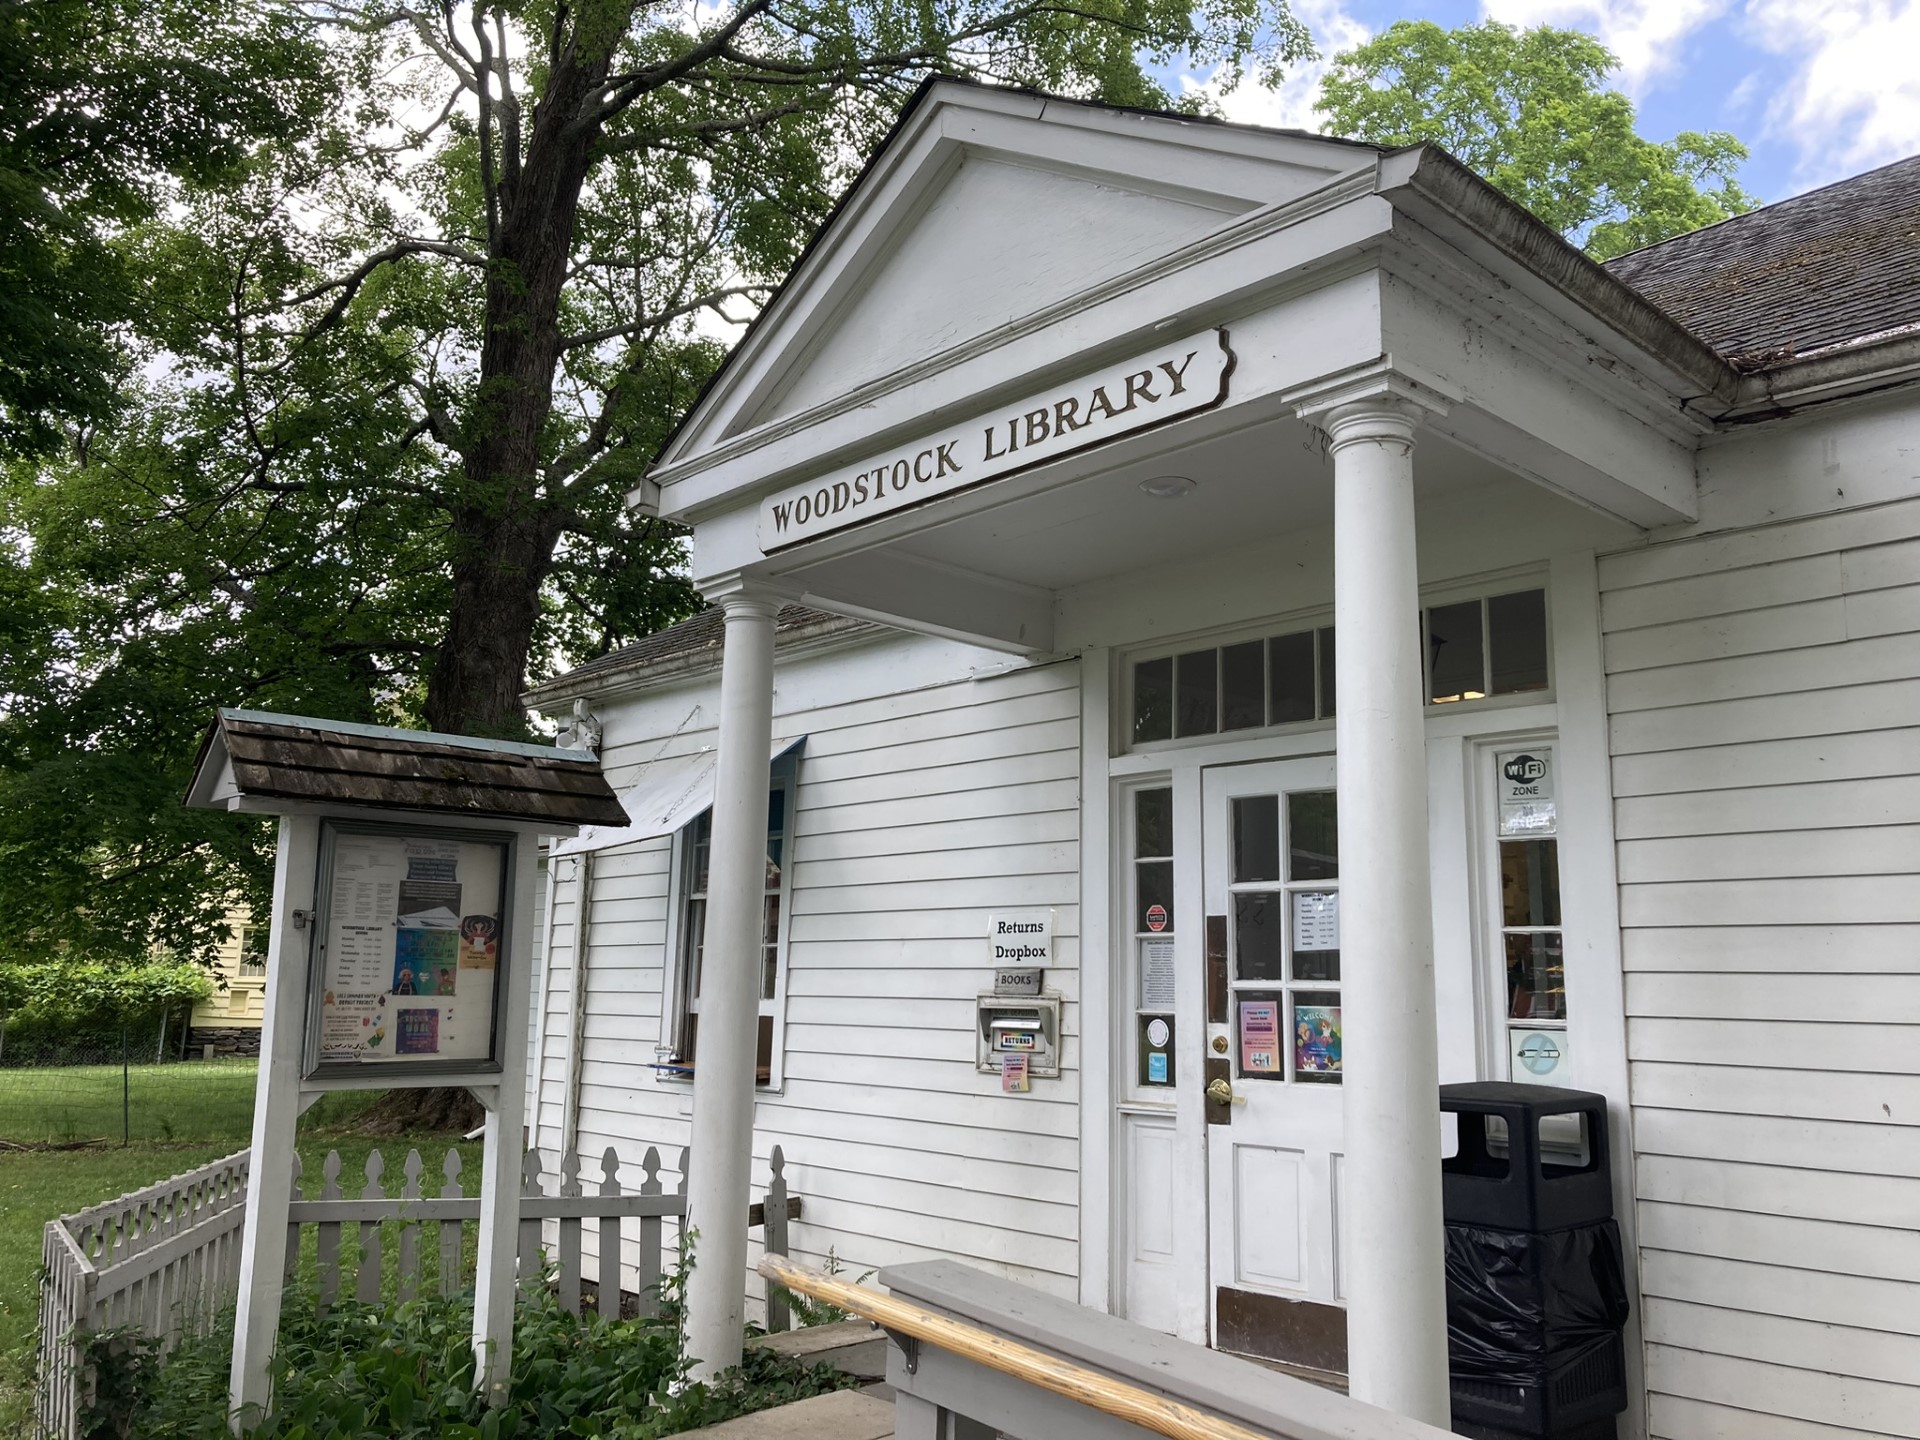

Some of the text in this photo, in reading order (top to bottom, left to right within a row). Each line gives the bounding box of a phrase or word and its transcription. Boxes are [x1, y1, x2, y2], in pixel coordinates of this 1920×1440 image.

[772, 351, 1198, 534] WOODSTOCK LIBRARY
[1513, 786, 1539, 796] ZONE
[997, 921, 1044, 934] Returns
[995, 945, 1046, 961] Dropbox
[1001, 975, 1031, 985] BOOKS
[1004, 1036, 1030, 1045] RETURNS
